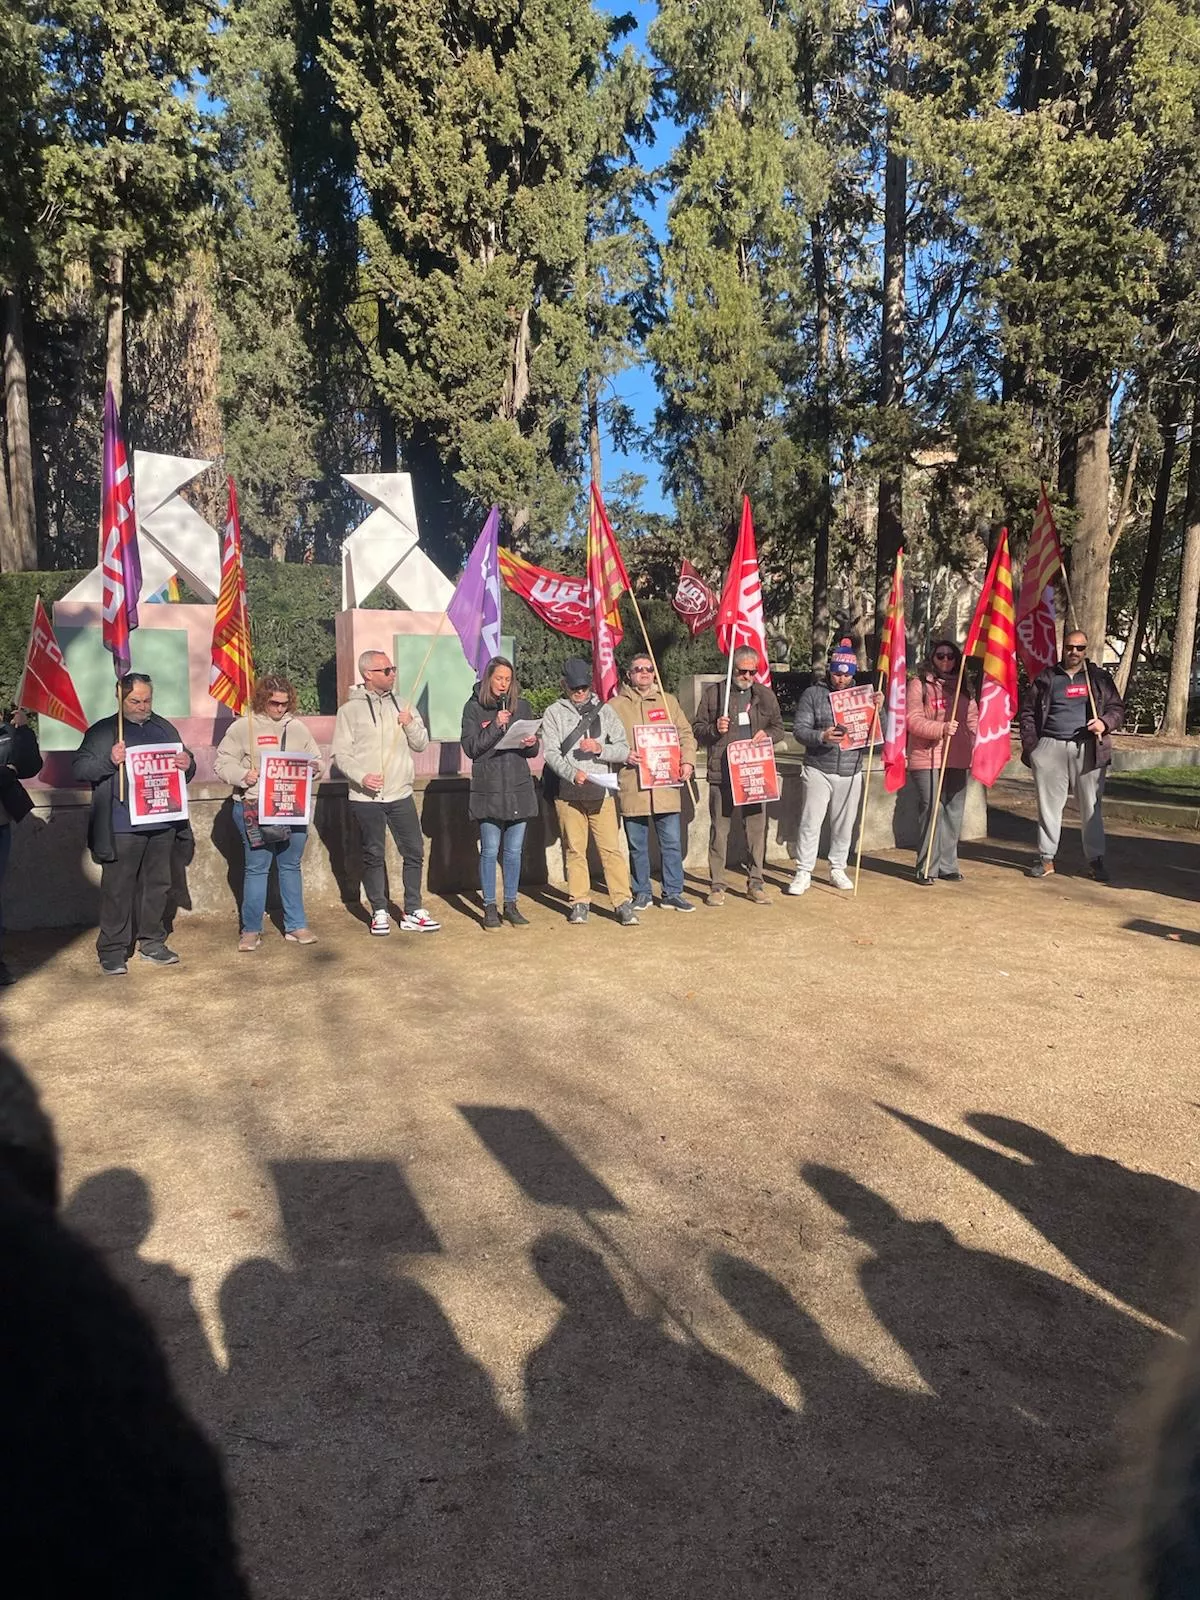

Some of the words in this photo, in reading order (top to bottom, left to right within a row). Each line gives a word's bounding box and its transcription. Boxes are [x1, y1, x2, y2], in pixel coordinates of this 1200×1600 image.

[637, 732, 678, 748] CALLE
[141, 753, 153, 761] LA
[729, 746, 772, 765] CALLE
[133, 758, 178, 776] CALLE
[266, 765, 307, 779] CALLE
